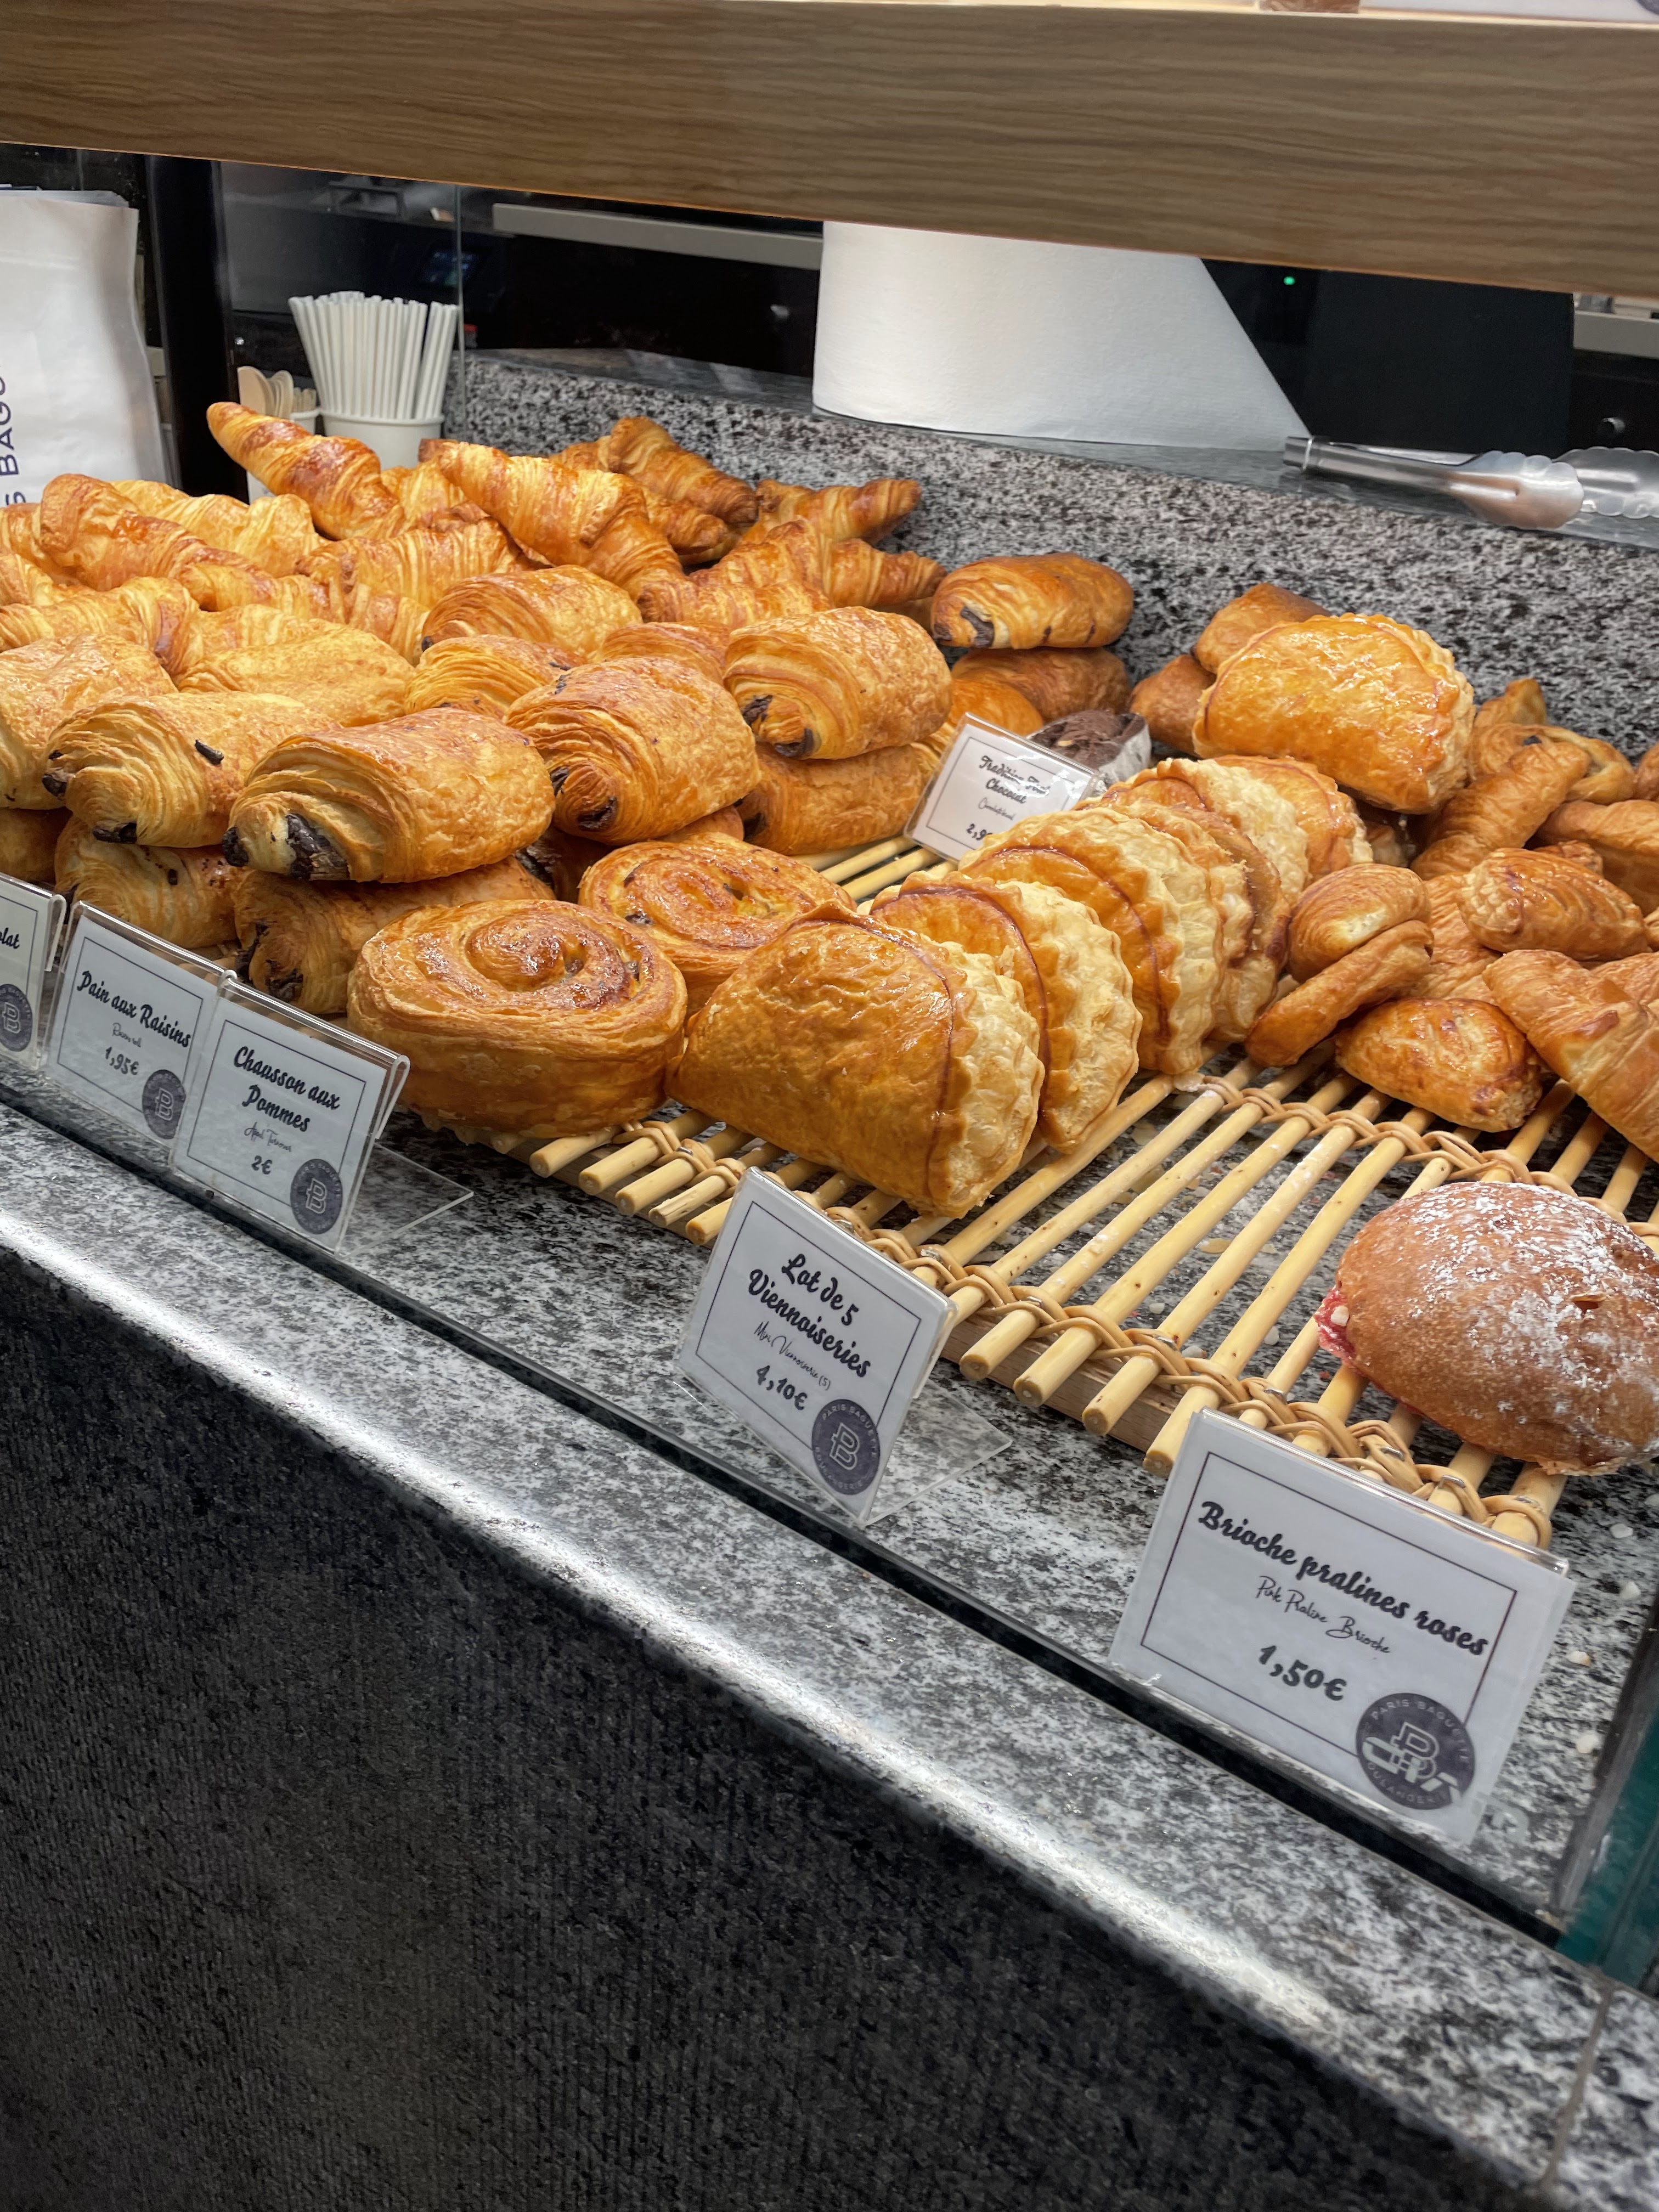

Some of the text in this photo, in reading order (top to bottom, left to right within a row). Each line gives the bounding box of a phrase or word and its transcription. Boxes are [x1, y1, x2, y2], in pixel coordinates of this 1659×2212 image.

[966, 823, 992, 841] 2,9
[0, 927, 20, 949] lat
[77, 970, 110, 1003] Pain
[111, 996, 137, 1019] aux
[140, 1004, 191, 1048] Raisins
[105, 1046, 139, 1076] 1,95€
[234, 1046, 340, 1110] Chausson aux
[242, 1084, 311, 1132] Pommes
[251, 1155, 273, 1175] 2€
[781, 1254, 859, 1326] Lot de 5
[748, 1269, 871, 1378] Viennoiseries
[757, 1365, 808, 1410] 4,10€
[818, 1375, 831, 1391] (5)
[822, 1404, 847, 1420] PARIS
[1198, 1501, 1488, 1656] Brioche pralines roses
[1284, 1589, 1328, 1623] Praline
[1325, 1616, 1391, 1654] Brioche
[1259, 1645, 1347, 1701] 1,50€
[1371, 1699, 1410, 1720] PARIS
